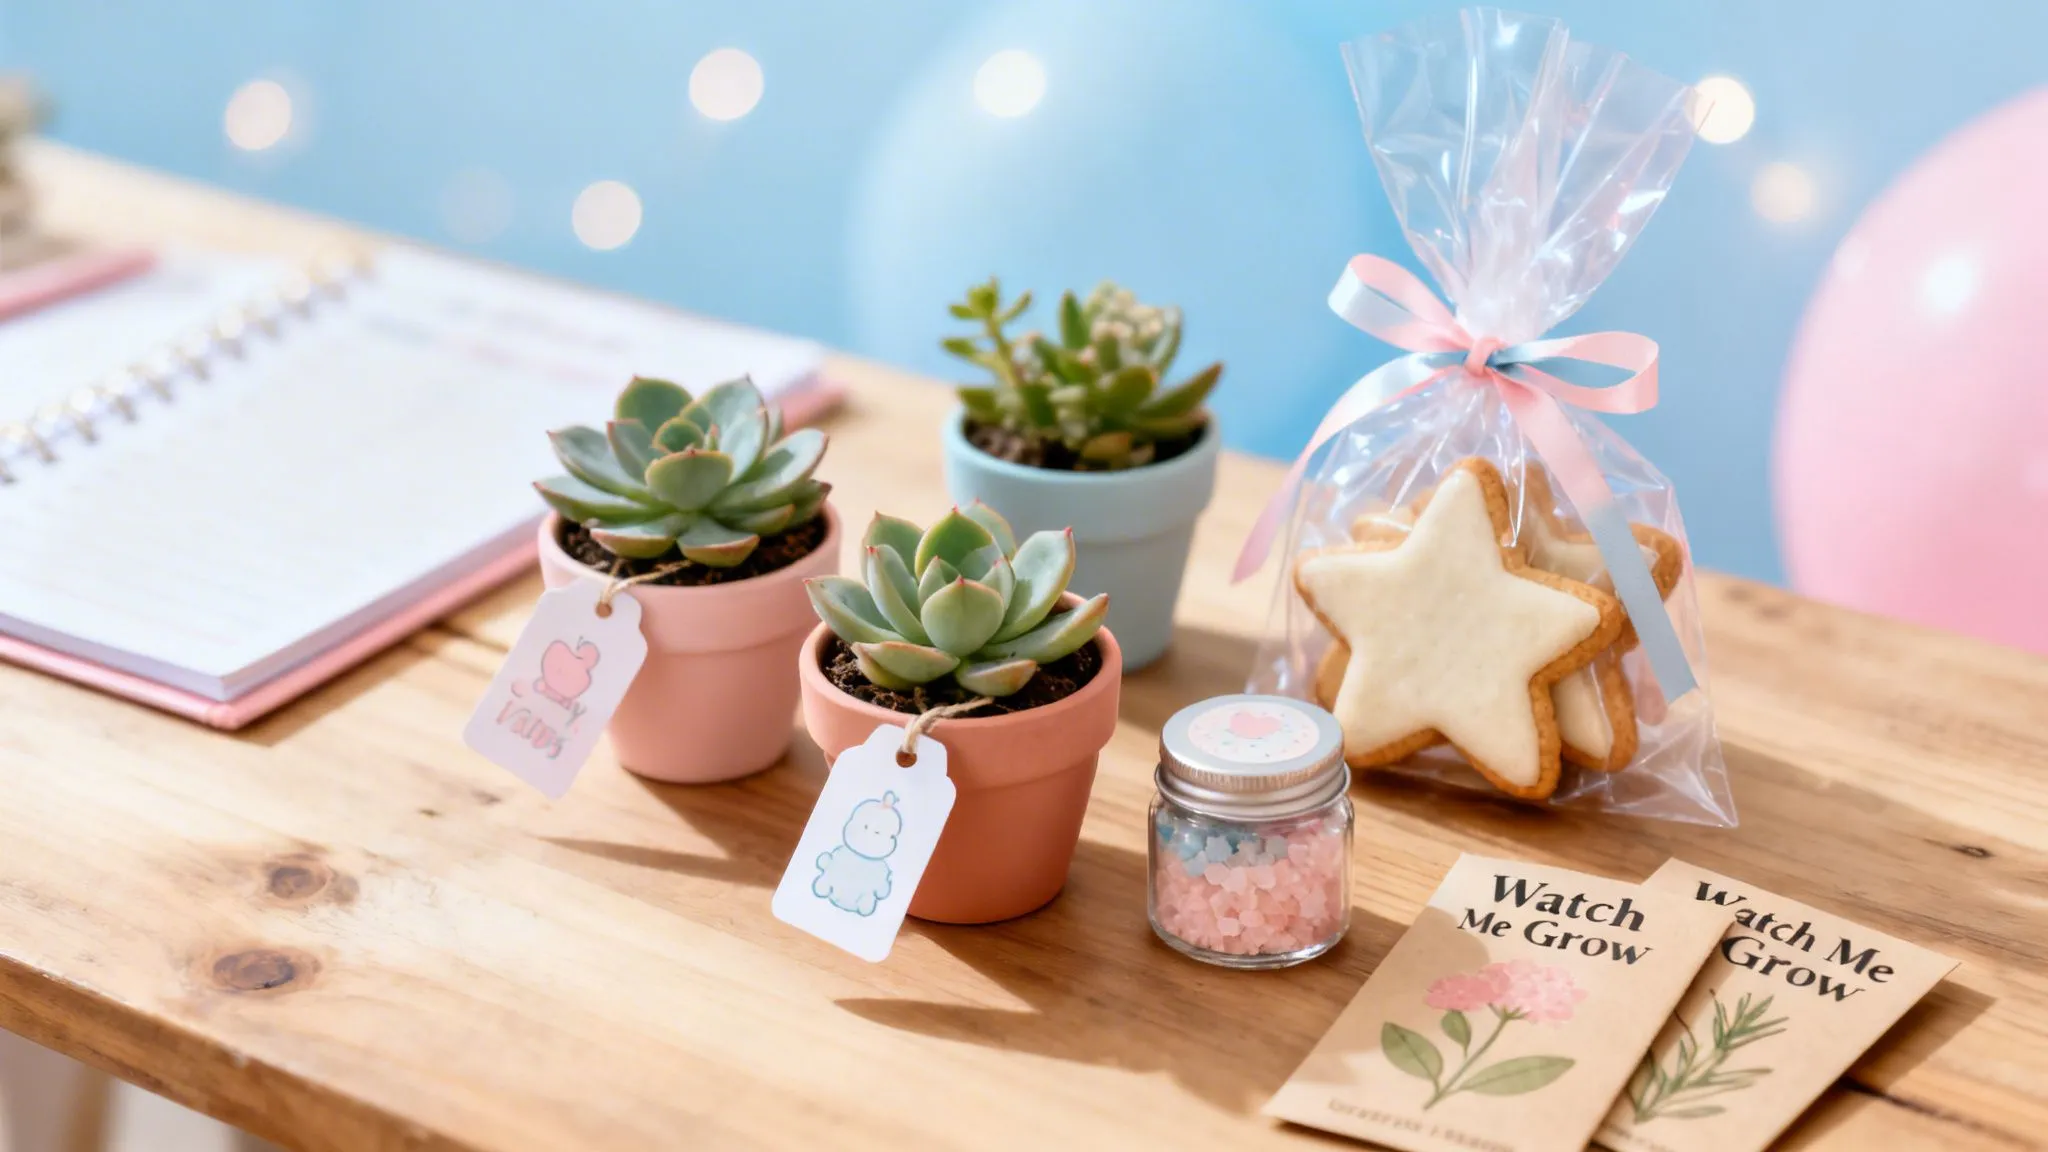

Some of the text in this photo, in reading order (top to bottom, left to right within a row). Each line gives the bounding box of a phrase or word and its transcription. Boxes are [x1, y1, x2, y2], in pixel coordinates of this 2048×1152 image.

[1493, 874, 1645, 932] Watch
[1694, 881, 1895, 983] Watch Me
[1456, 907, 1653, 965] Me Grow
[1720, 935, 1867, 1002] Grow
